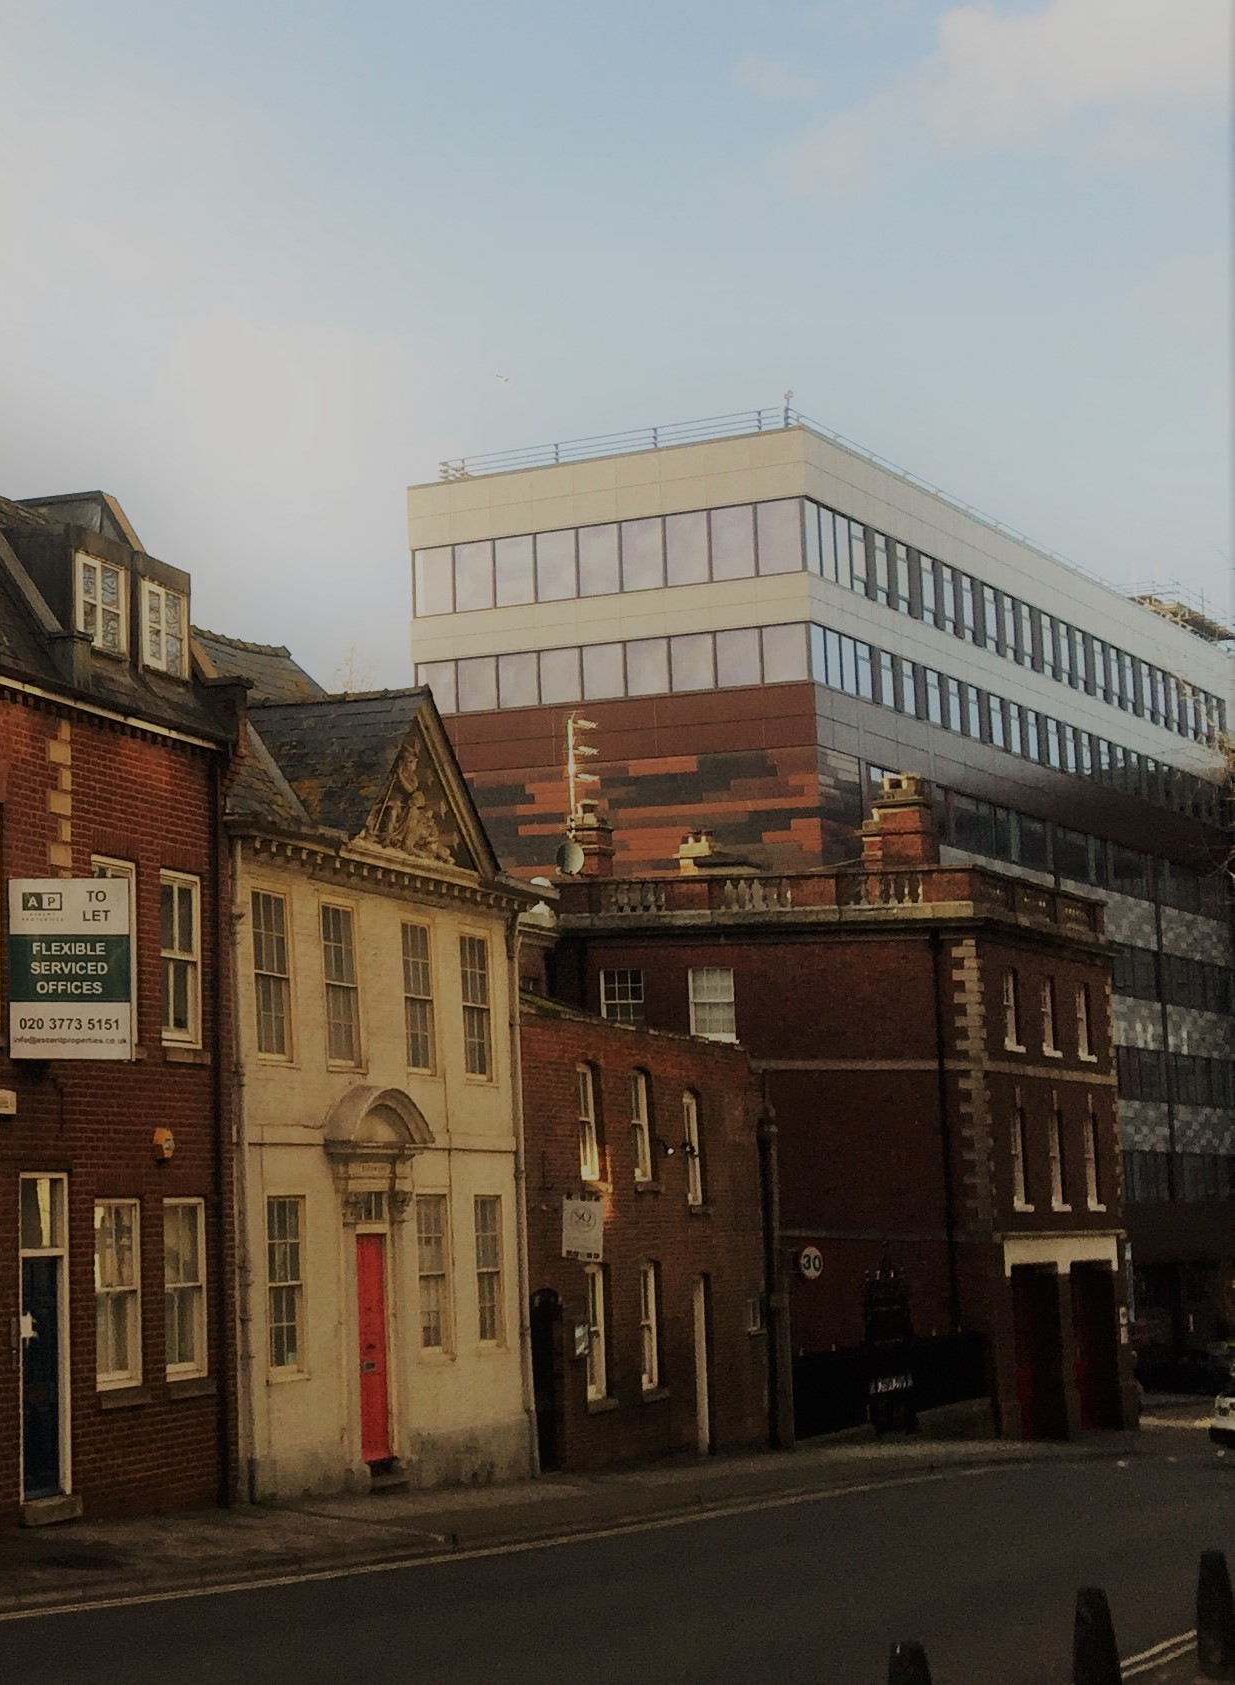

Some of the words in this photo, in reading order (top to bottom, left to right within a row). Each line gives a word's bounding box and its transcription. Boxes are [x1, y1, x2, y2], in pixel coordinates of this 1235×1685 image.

[86, 890, 106, 903] TO
[83, 910, 110, 922] LET
[32, 942, 106, 956] FLEXIBLE
[30, 962, 108, 975] SERVICED
[36, 981, 103, 995] OFFICES
[19, 1018, 44, 1030] 020
[49, 1018, 82, 1030] 3773
[87, 1018, 119, 1030] 5151
[803, 1254, 821, 1271] 30
